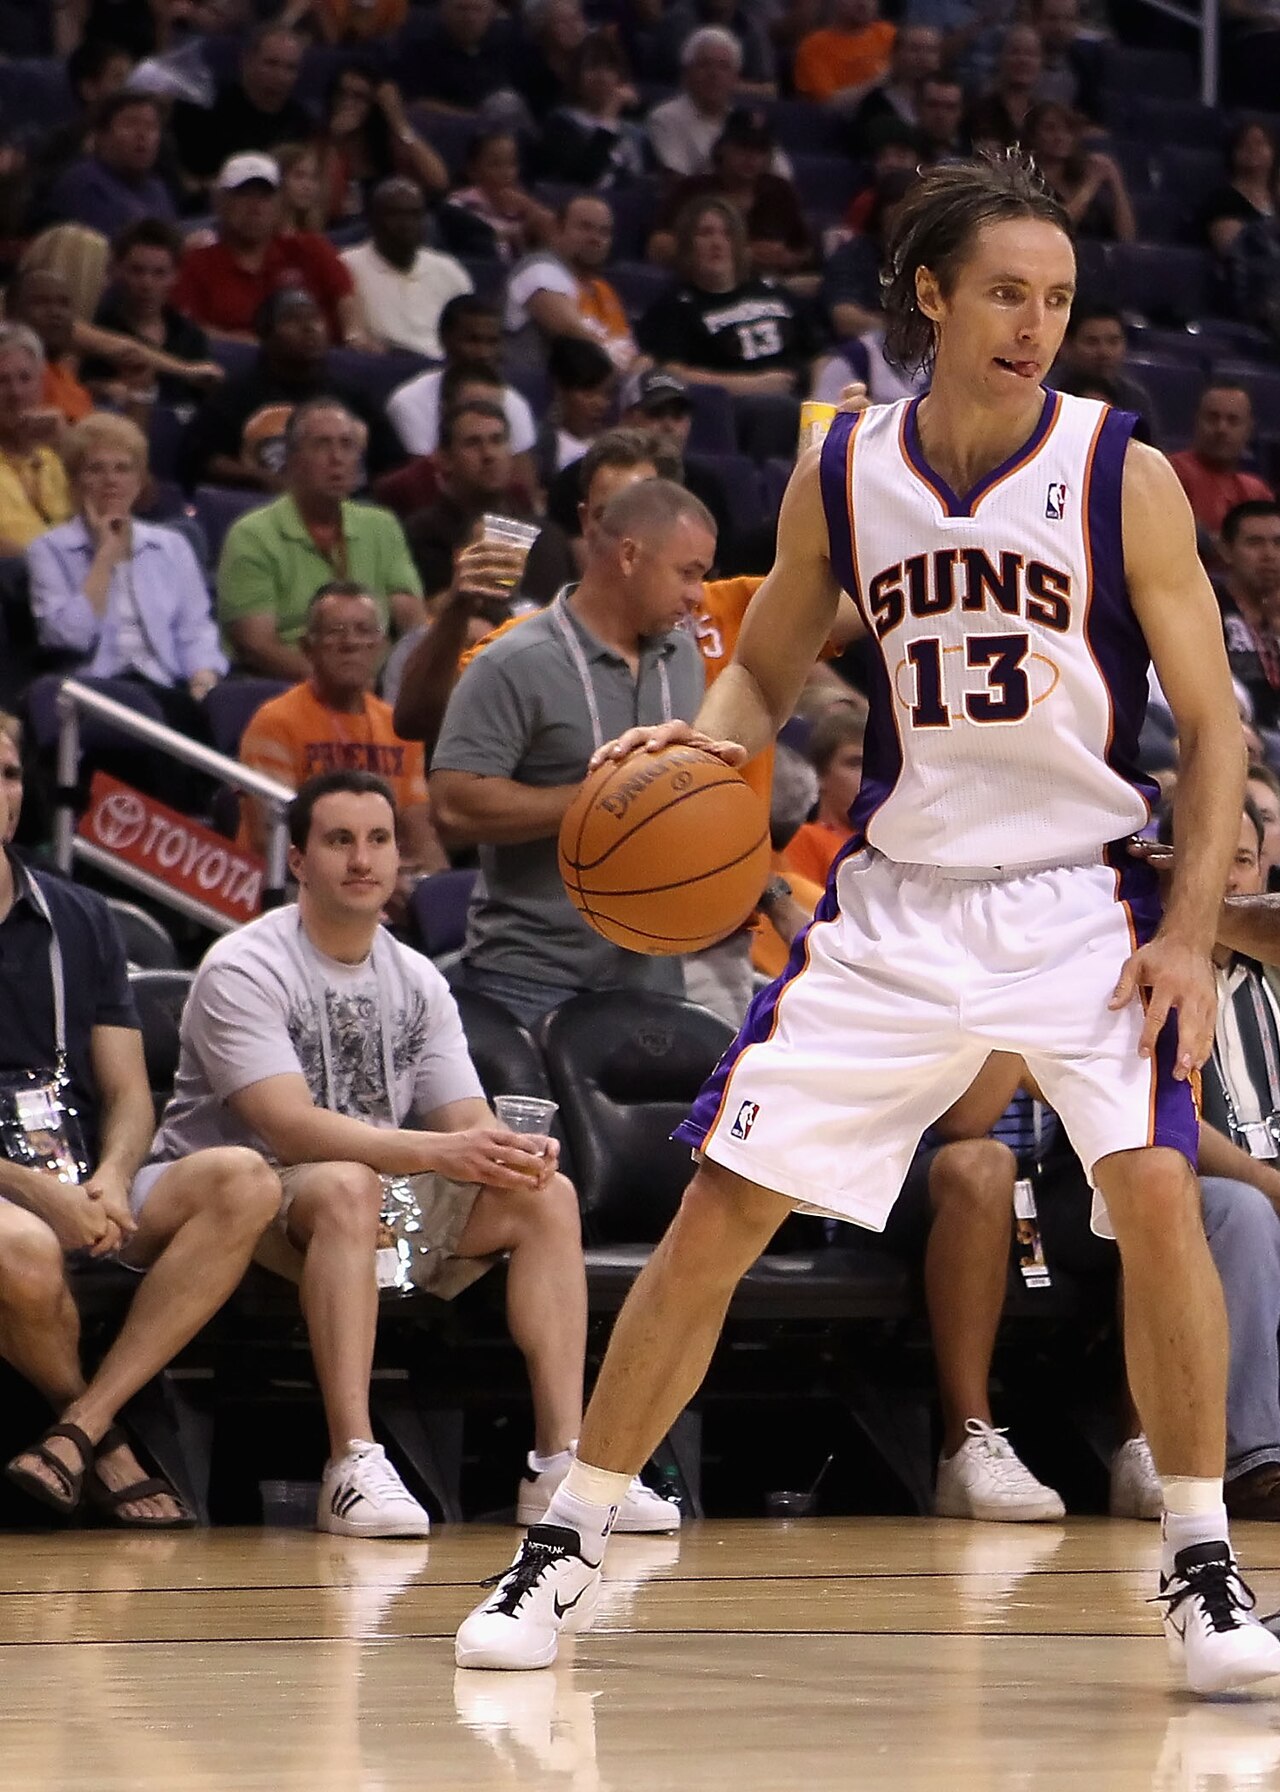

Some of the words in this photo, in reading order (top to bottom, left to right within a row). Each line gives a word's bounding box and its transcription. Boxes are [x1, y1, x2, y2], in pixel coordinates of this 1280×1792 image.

[868, 548, 1073, 641] SUNS
[904, 632, 1033, 731] 13
[143, 816, 264, 912] TOYOTA
